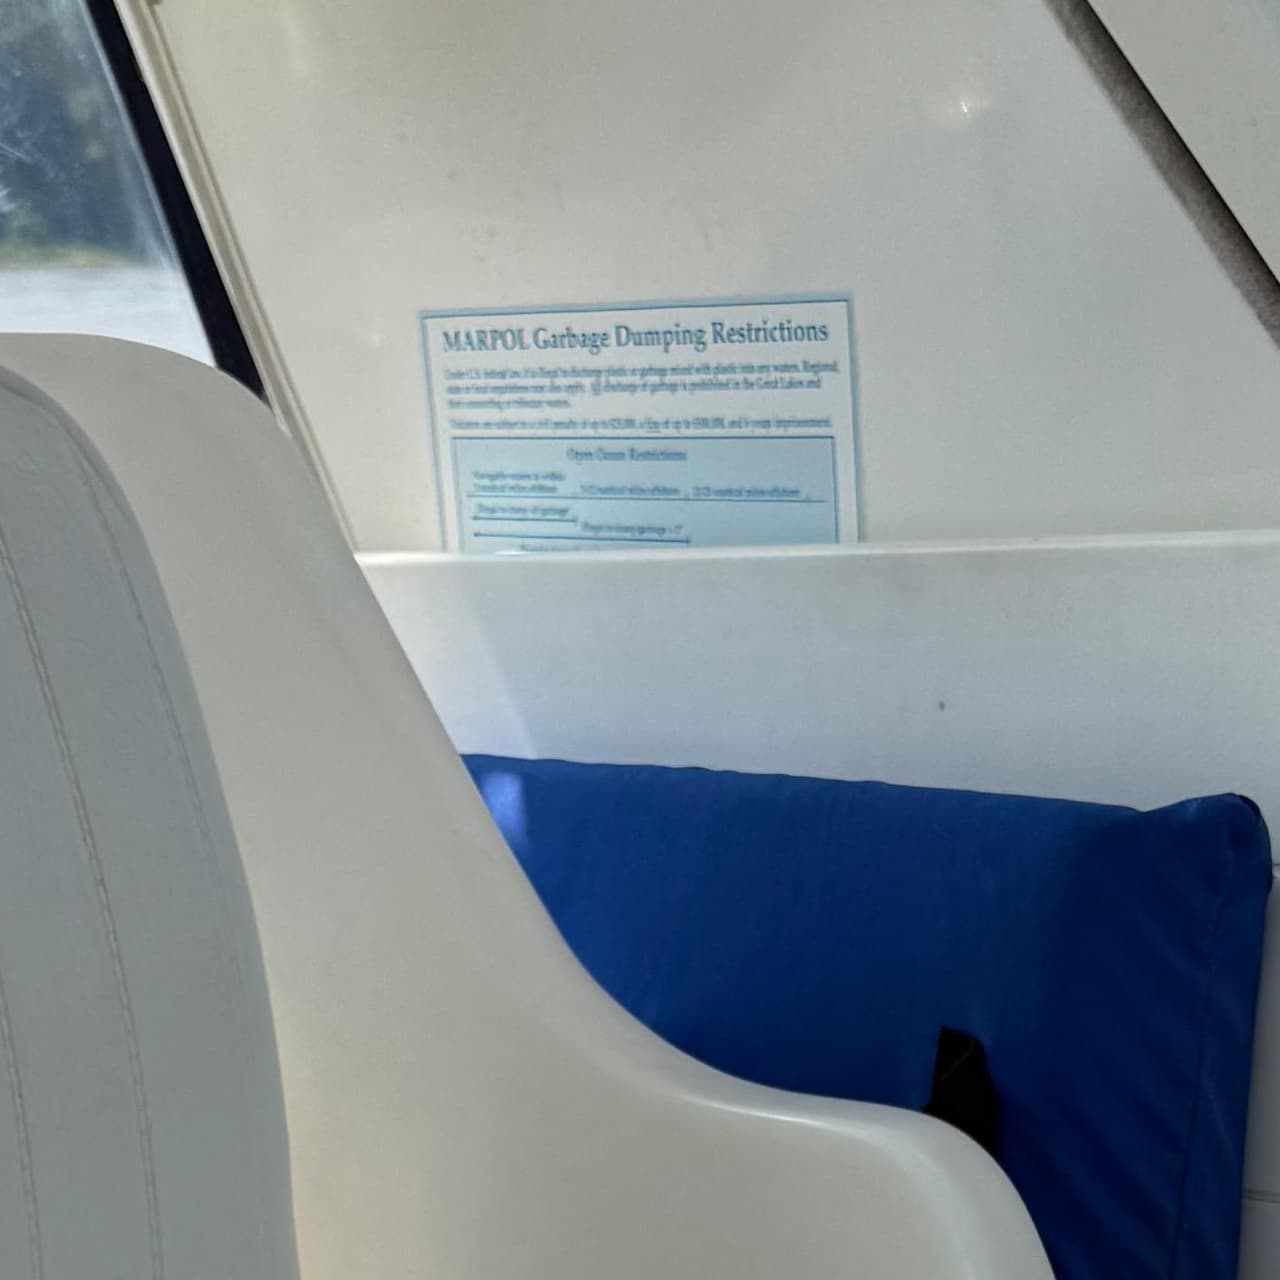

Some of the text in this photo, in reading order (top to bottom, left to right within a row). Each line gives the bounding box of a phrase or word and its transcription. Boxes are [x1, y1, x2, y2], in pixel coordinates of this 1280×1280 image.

[443, 317, 829, 356] MARPOL Garbage Dumping Restrictions
